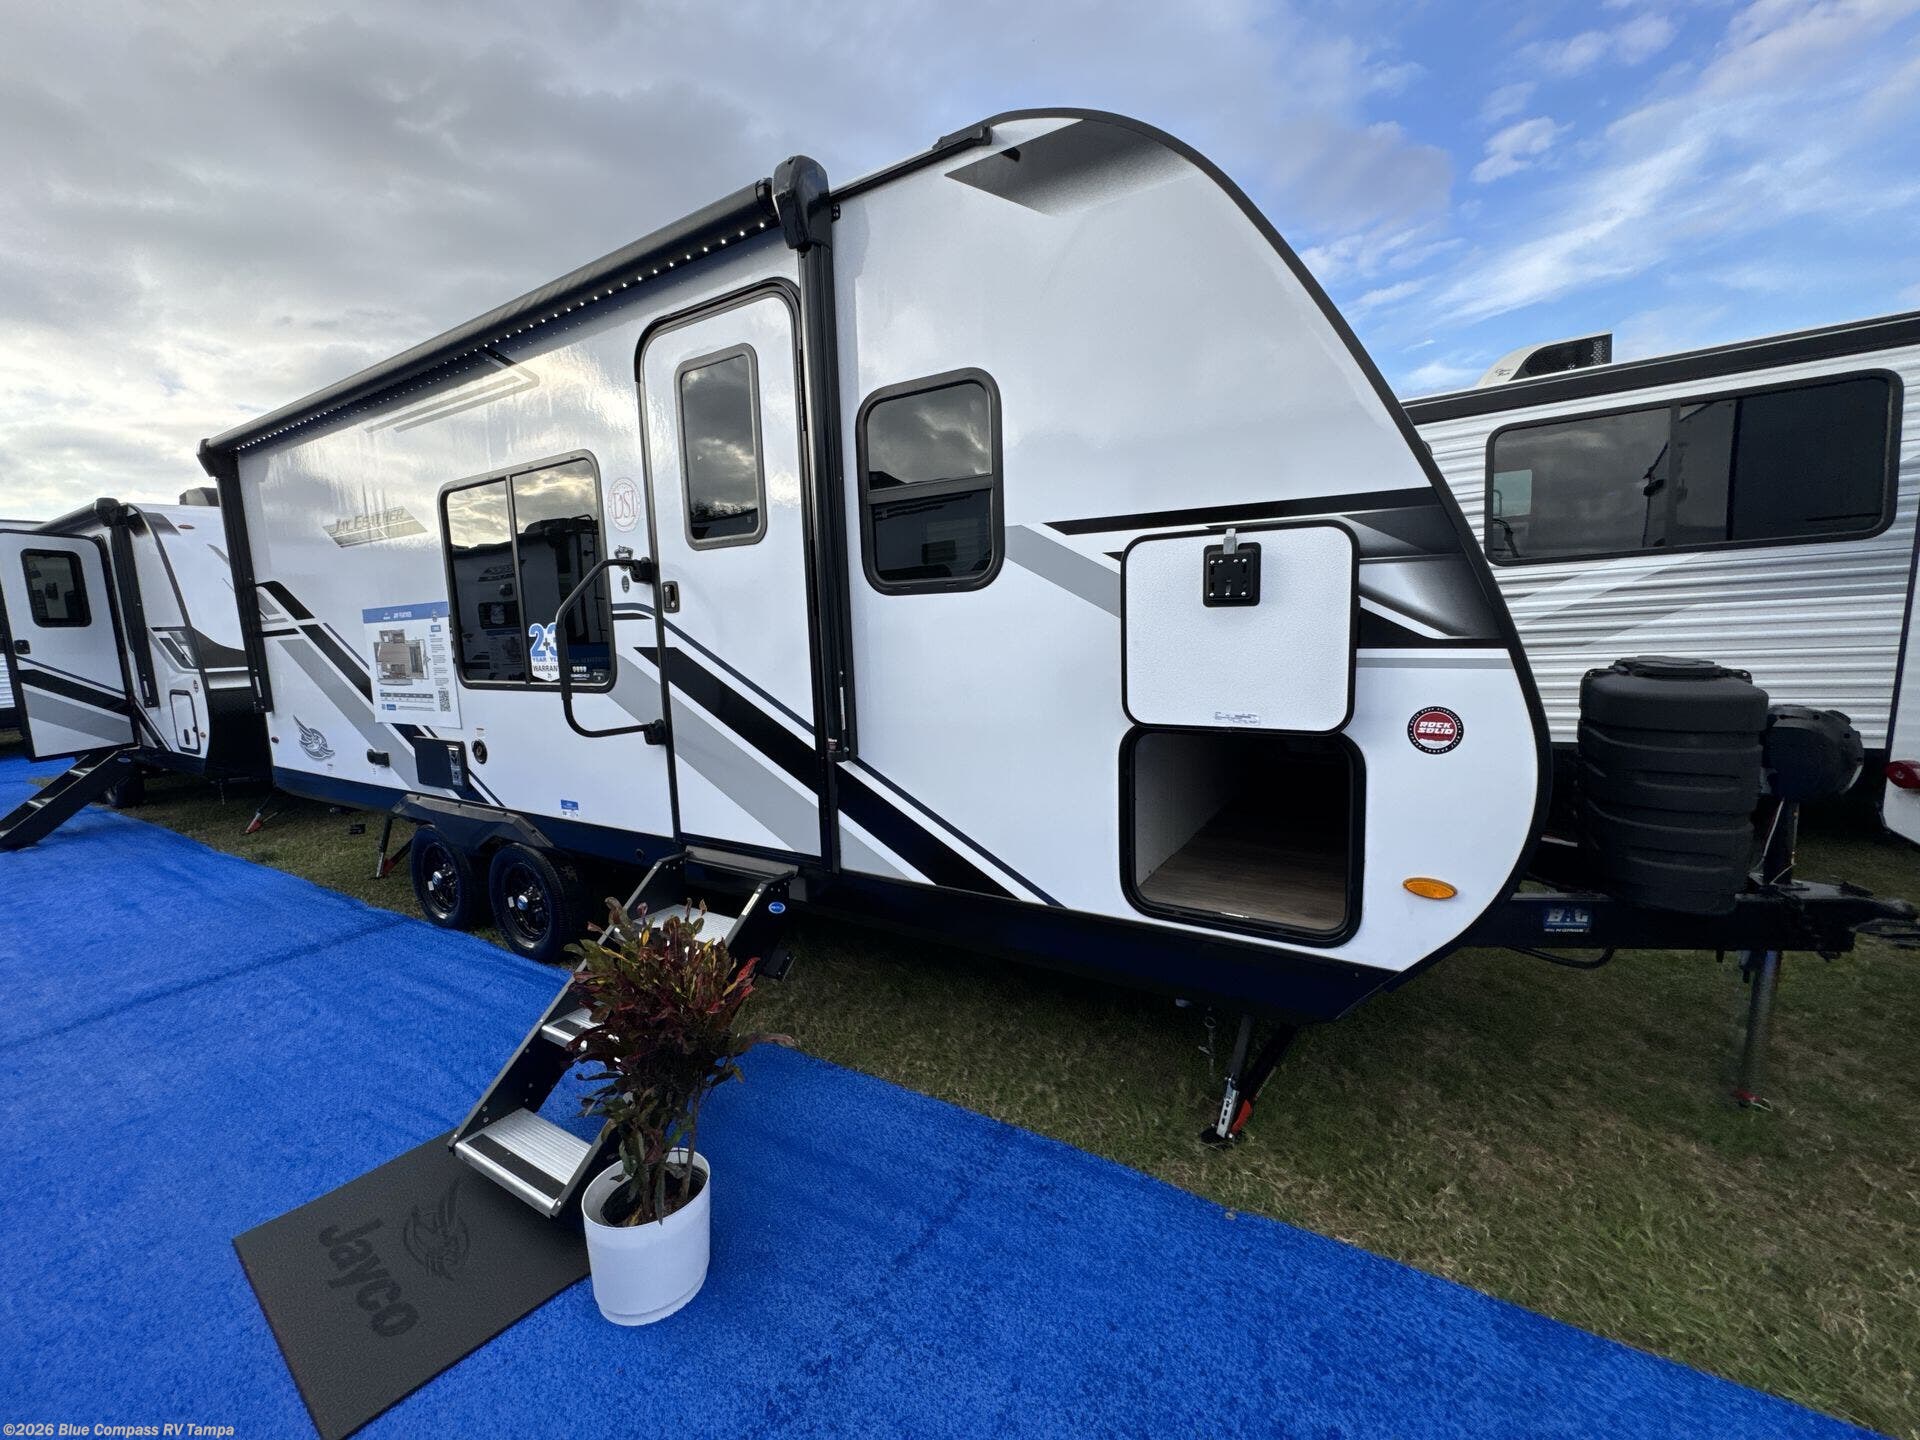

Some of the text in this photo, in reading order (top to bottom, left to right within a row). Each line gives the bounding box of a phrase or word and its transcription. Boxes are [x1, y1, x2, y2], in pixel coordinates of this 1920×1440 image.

[335, 508, 404, 533] JAY FEATHER
[532, 664, 560, 673] WARRAN
[1417, 727, 1454, 735] SOLID
[318, 1217, 420, 1338] Jayco
